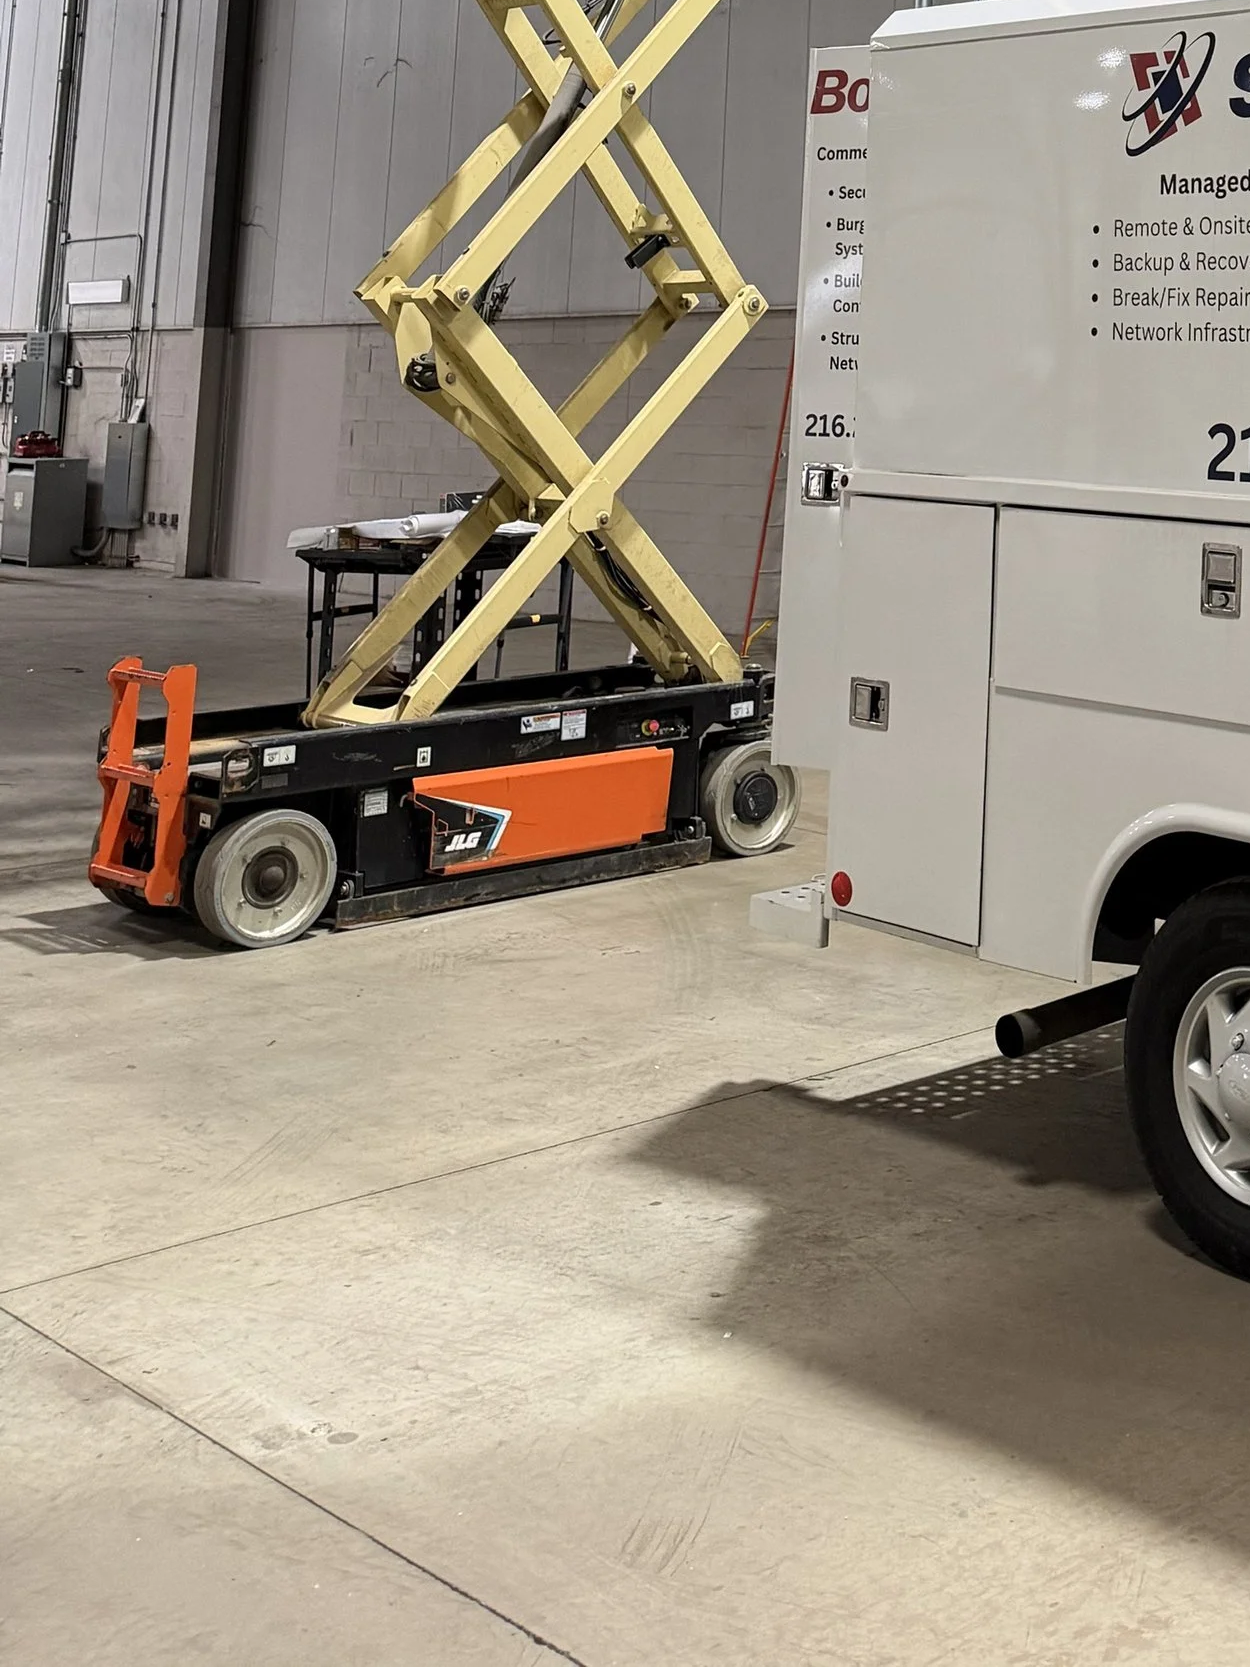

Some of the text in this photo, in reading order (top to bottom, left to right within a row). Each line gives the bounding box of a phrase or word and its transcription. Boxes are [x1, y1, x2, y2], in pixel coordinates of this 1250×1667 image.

[1114, 219, 1178, 237] Remote
[1183, 217, 1194, 235] &
[1113, 252, 1174, 275] Backup
[1179, 252, 1191, 271] &
[834, 274, 862, 288] Buil
[833, 299, 861, 313] Con
[1113, 287, 1250, 311] Break/Fix Repair
[1112, 322, 1183, 342] Network
[830, 356, 858, 370] Net
[805, 413, 855, 438] 216.
[444, 831, 482, 852] JLG
